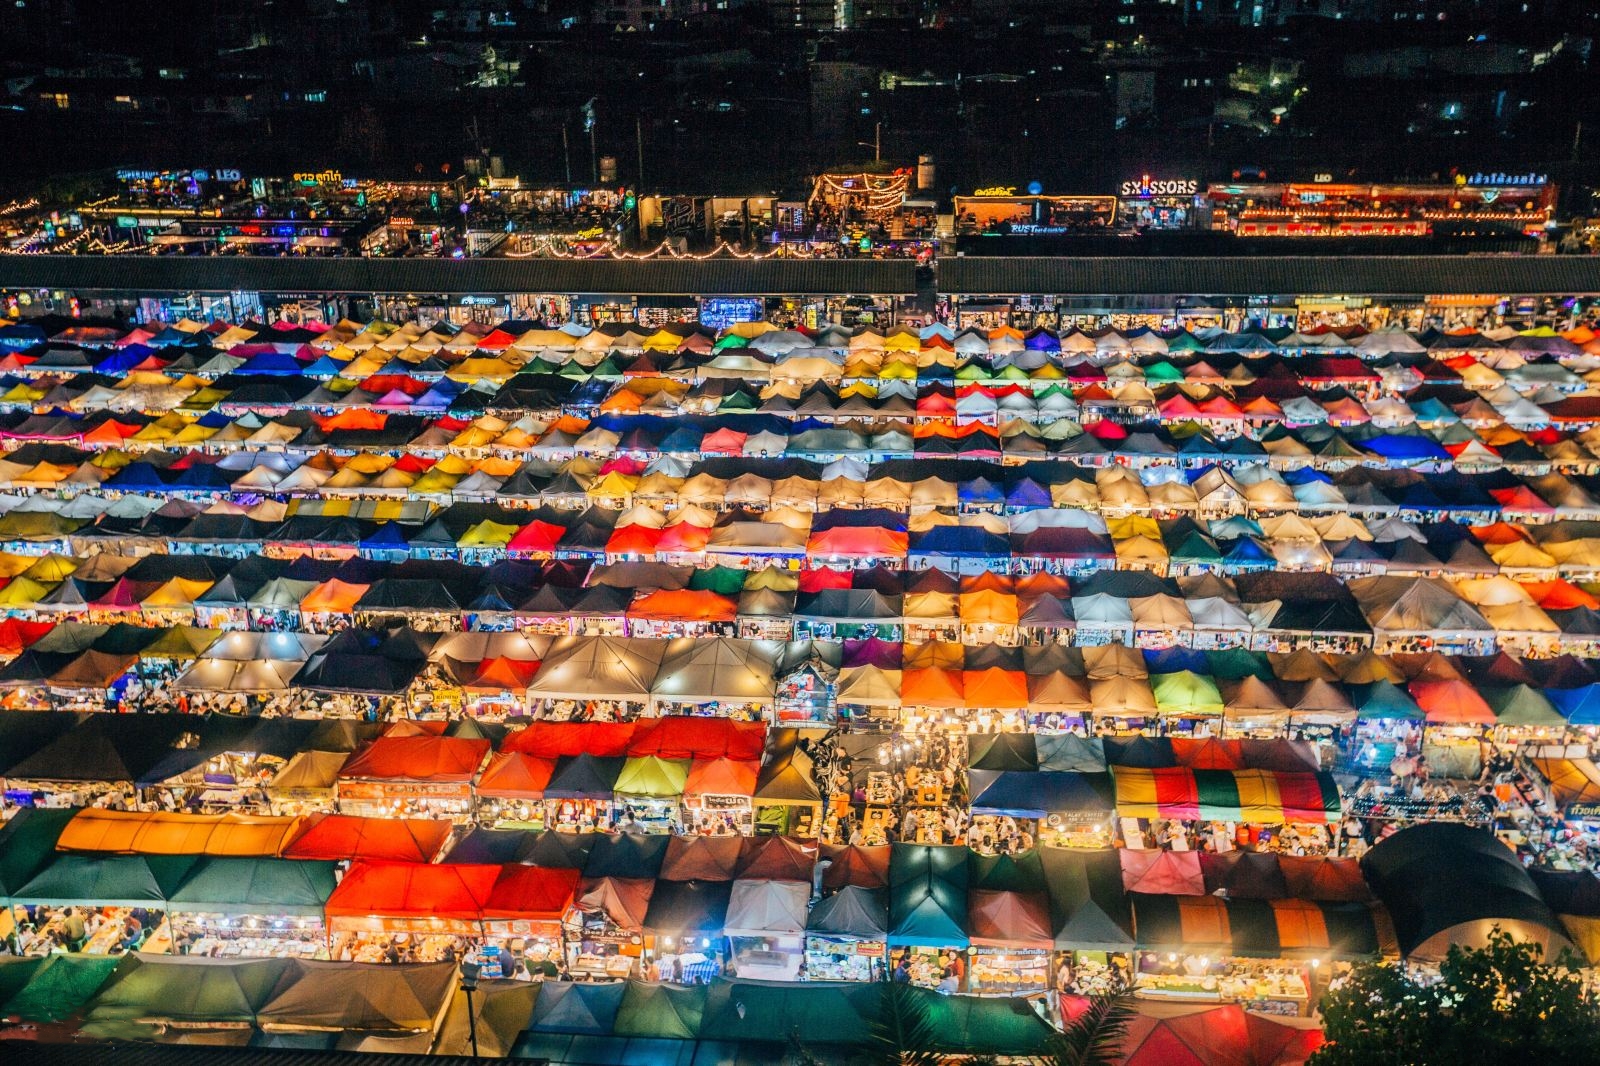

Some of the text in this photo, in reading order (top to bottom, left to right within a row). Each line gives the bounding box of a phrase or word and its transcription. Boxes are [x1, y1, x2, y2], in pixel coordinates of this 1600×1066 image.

[216, 169, 239, 181] LEO
[1314, 174, 1332, 182] LEO
[1011, 224, 1038, 233] RUST
